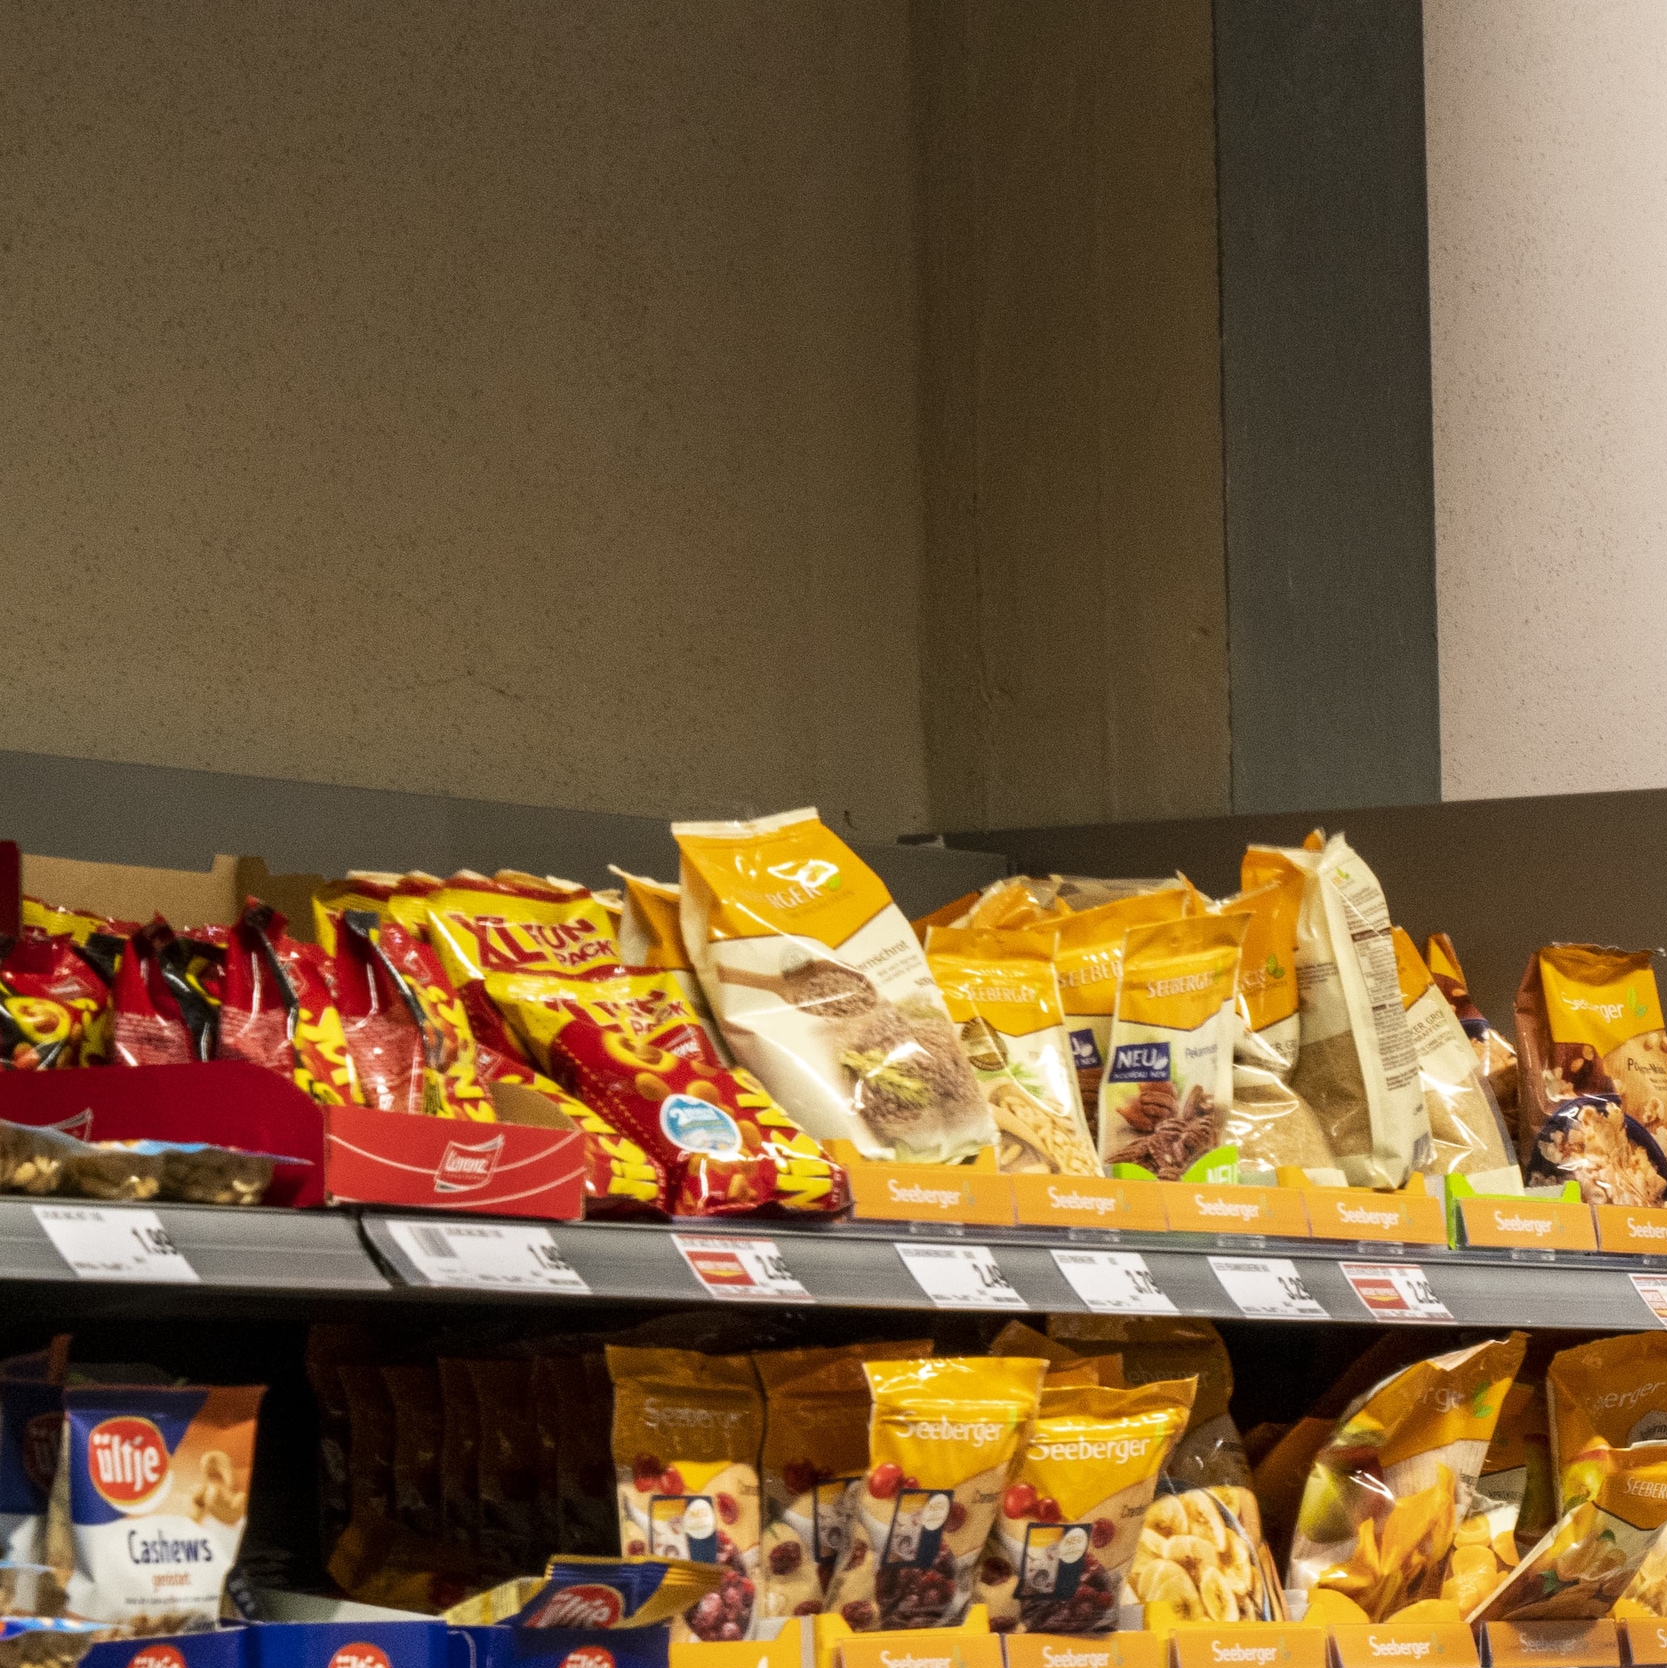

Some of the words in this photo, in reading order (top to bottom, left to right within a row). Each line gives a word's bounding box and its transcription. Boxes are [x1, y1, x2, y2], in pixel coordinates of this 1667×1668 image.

[451, 913, 548, 969] XL
[556, 937, 615, 968] PACK
[1114, 1045, 1155, 1072] NEU
[444, 1149, 487, 1173] Lorenz
[890, 1185, 961, 1207] Seeberger
[1048, 1187, 1117, 1213] Seeberger
[1194, 1196, 1260, 1220] Seeberger
[1337, 1203, 1400, 1227] Seeberger
[1494, 1213, 1553, 1235] Seeberger
[896, 1416, 1003, 1444] Seeberger
[95, 1430, 162, 1484] ültje
[1031, 1434, 1150, 1463] Seeberger
[127, 1532, 211, 1564] Cashews
[1211, 1642, 1277, 1662] Seeberger
[1369, 1637, 1430, 1656] Seeberger
[1519, 1634, 1575, 1652] Seeberger
[1043, 1647, 1110, 1668] Seeberger
